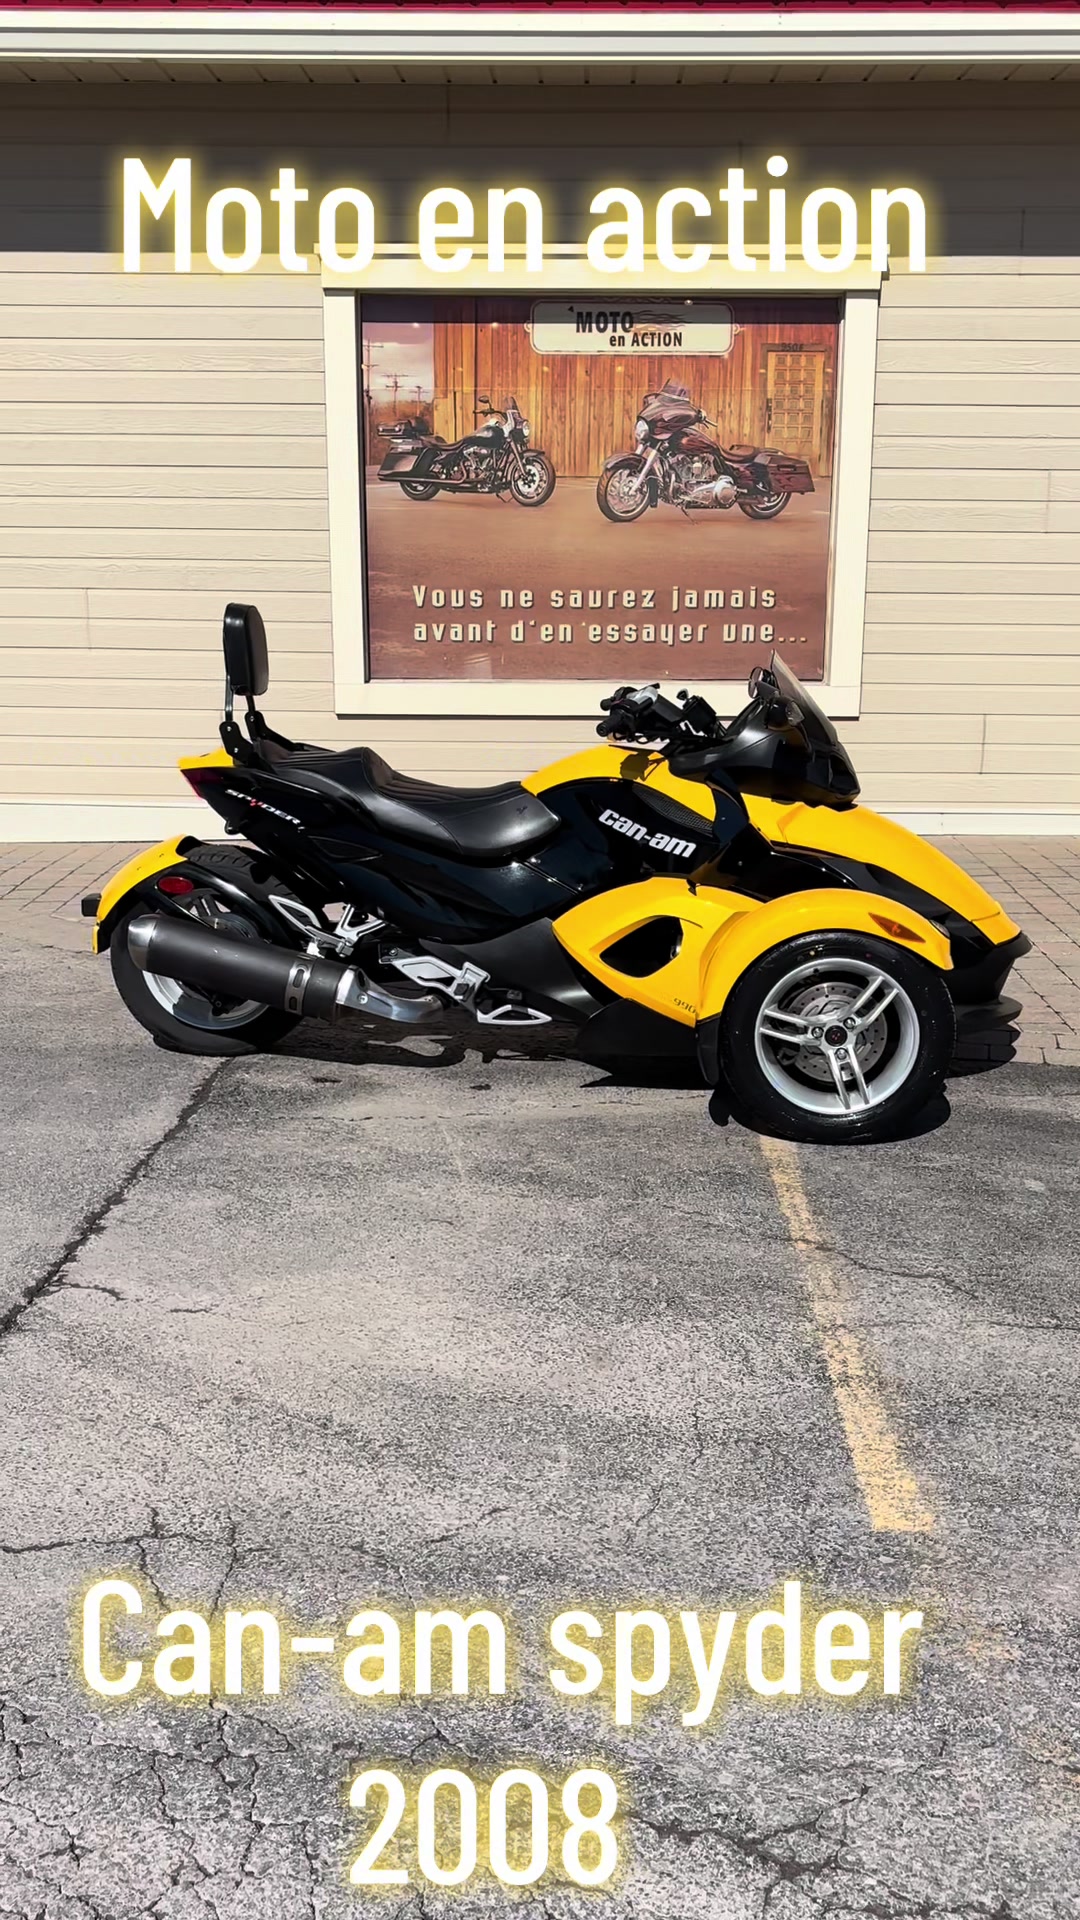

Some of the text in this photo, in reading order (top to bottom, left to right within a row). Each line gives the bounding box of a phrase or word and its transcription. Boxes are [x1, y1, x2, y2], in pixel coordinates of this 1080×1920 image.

[576, 311, 635, 334] MOTO
[609, 332, 683, 347] en ACTION
[412, 585, 777, 612] Vous ne saurez jamais
[413, 620, 808, 645] avant d'en essayer une...
[598, 808, 697, 858] can-am
[673, 997, 698, 1014] 990
